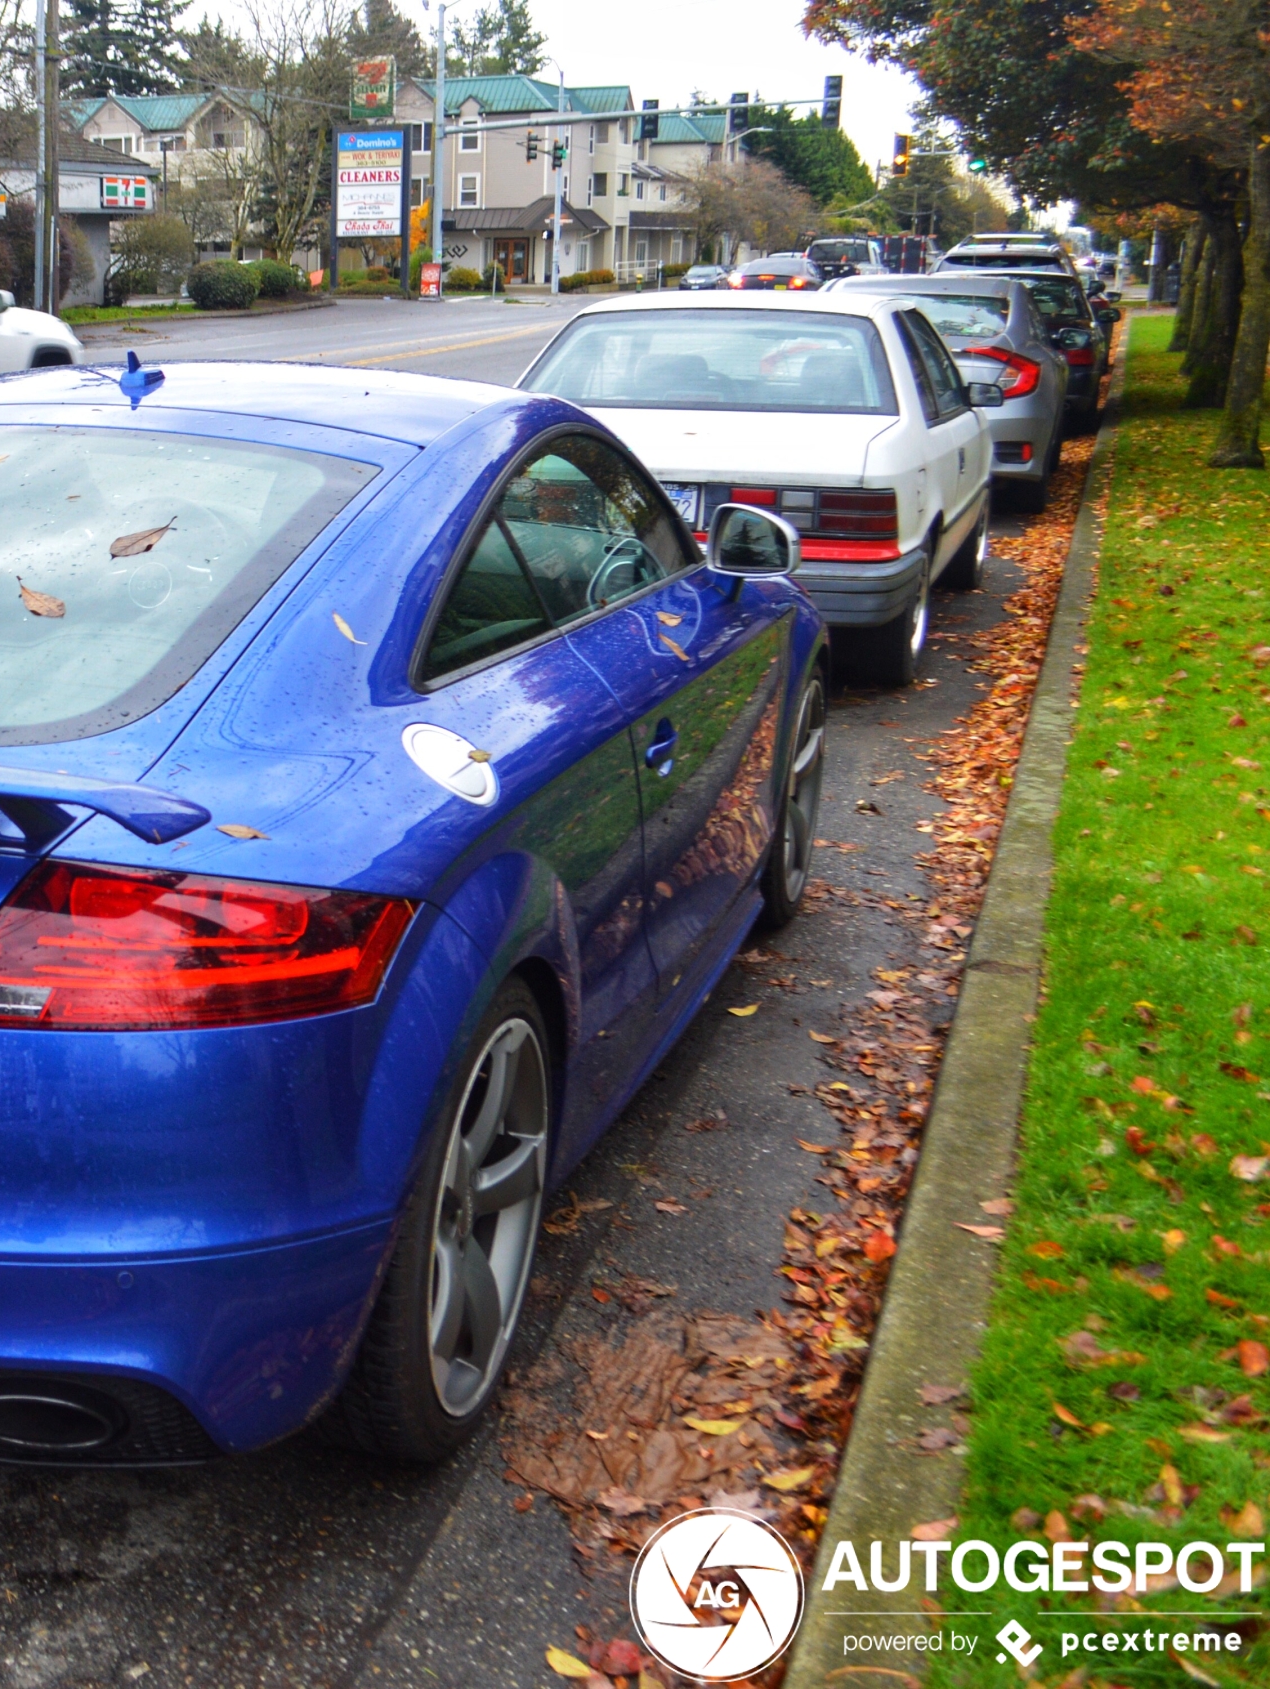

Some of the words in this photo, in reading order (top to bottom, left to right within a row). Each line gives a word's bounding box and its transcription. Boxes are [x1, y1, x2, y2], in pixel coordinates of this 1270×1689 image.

[356, 138, 397, 148] Domino's
[352, 152, 366, 161] WOK
[375, 150, 401, 160] TERIYAKI
[340, 170, 400, 183] CLEANERS
[344, 220, 370, 231] Chada
[373, 220, 393, 231] Thai
